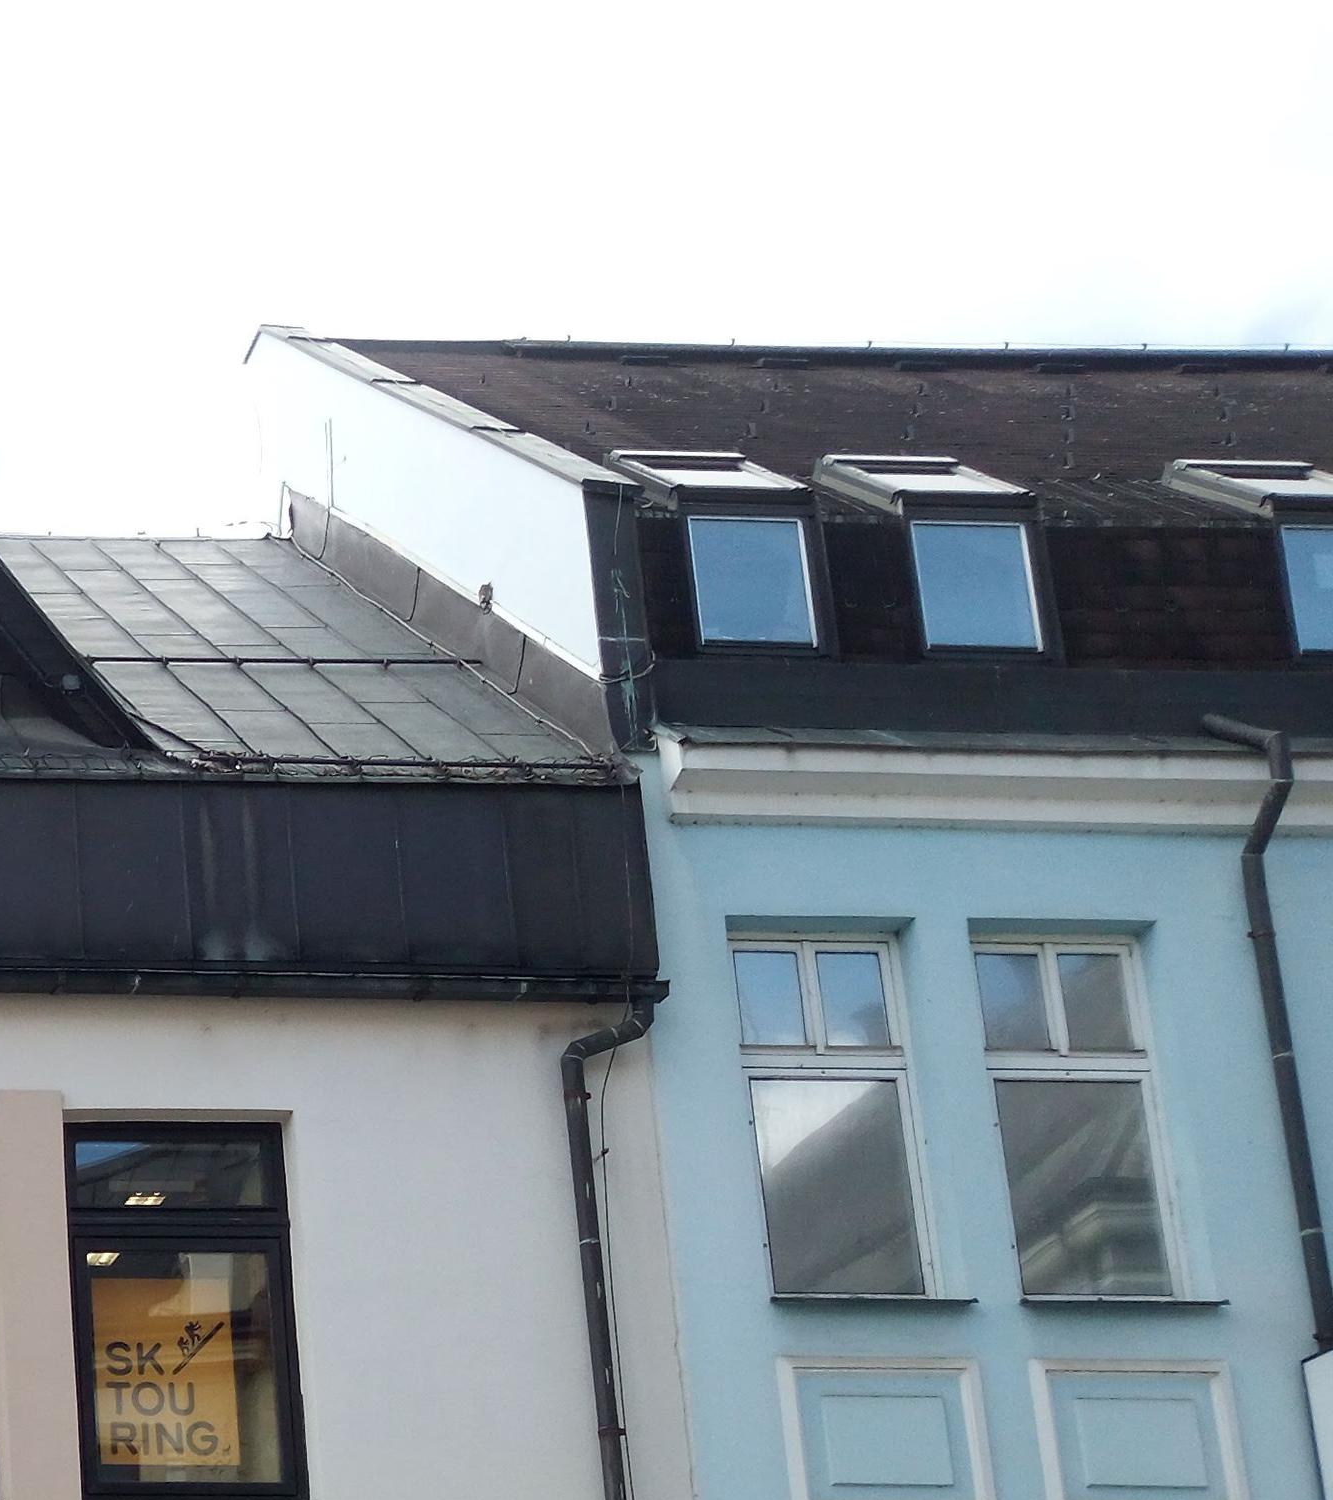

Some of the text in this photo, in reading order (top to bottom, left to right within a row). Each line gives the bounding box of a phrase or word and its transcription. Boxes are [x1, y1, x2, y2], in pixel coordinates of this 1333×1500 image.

[105, 1341, 165, 1376] SK
[105, 1381, 195, 1416] TOU
[110, 1420, 219, 1457] RING
